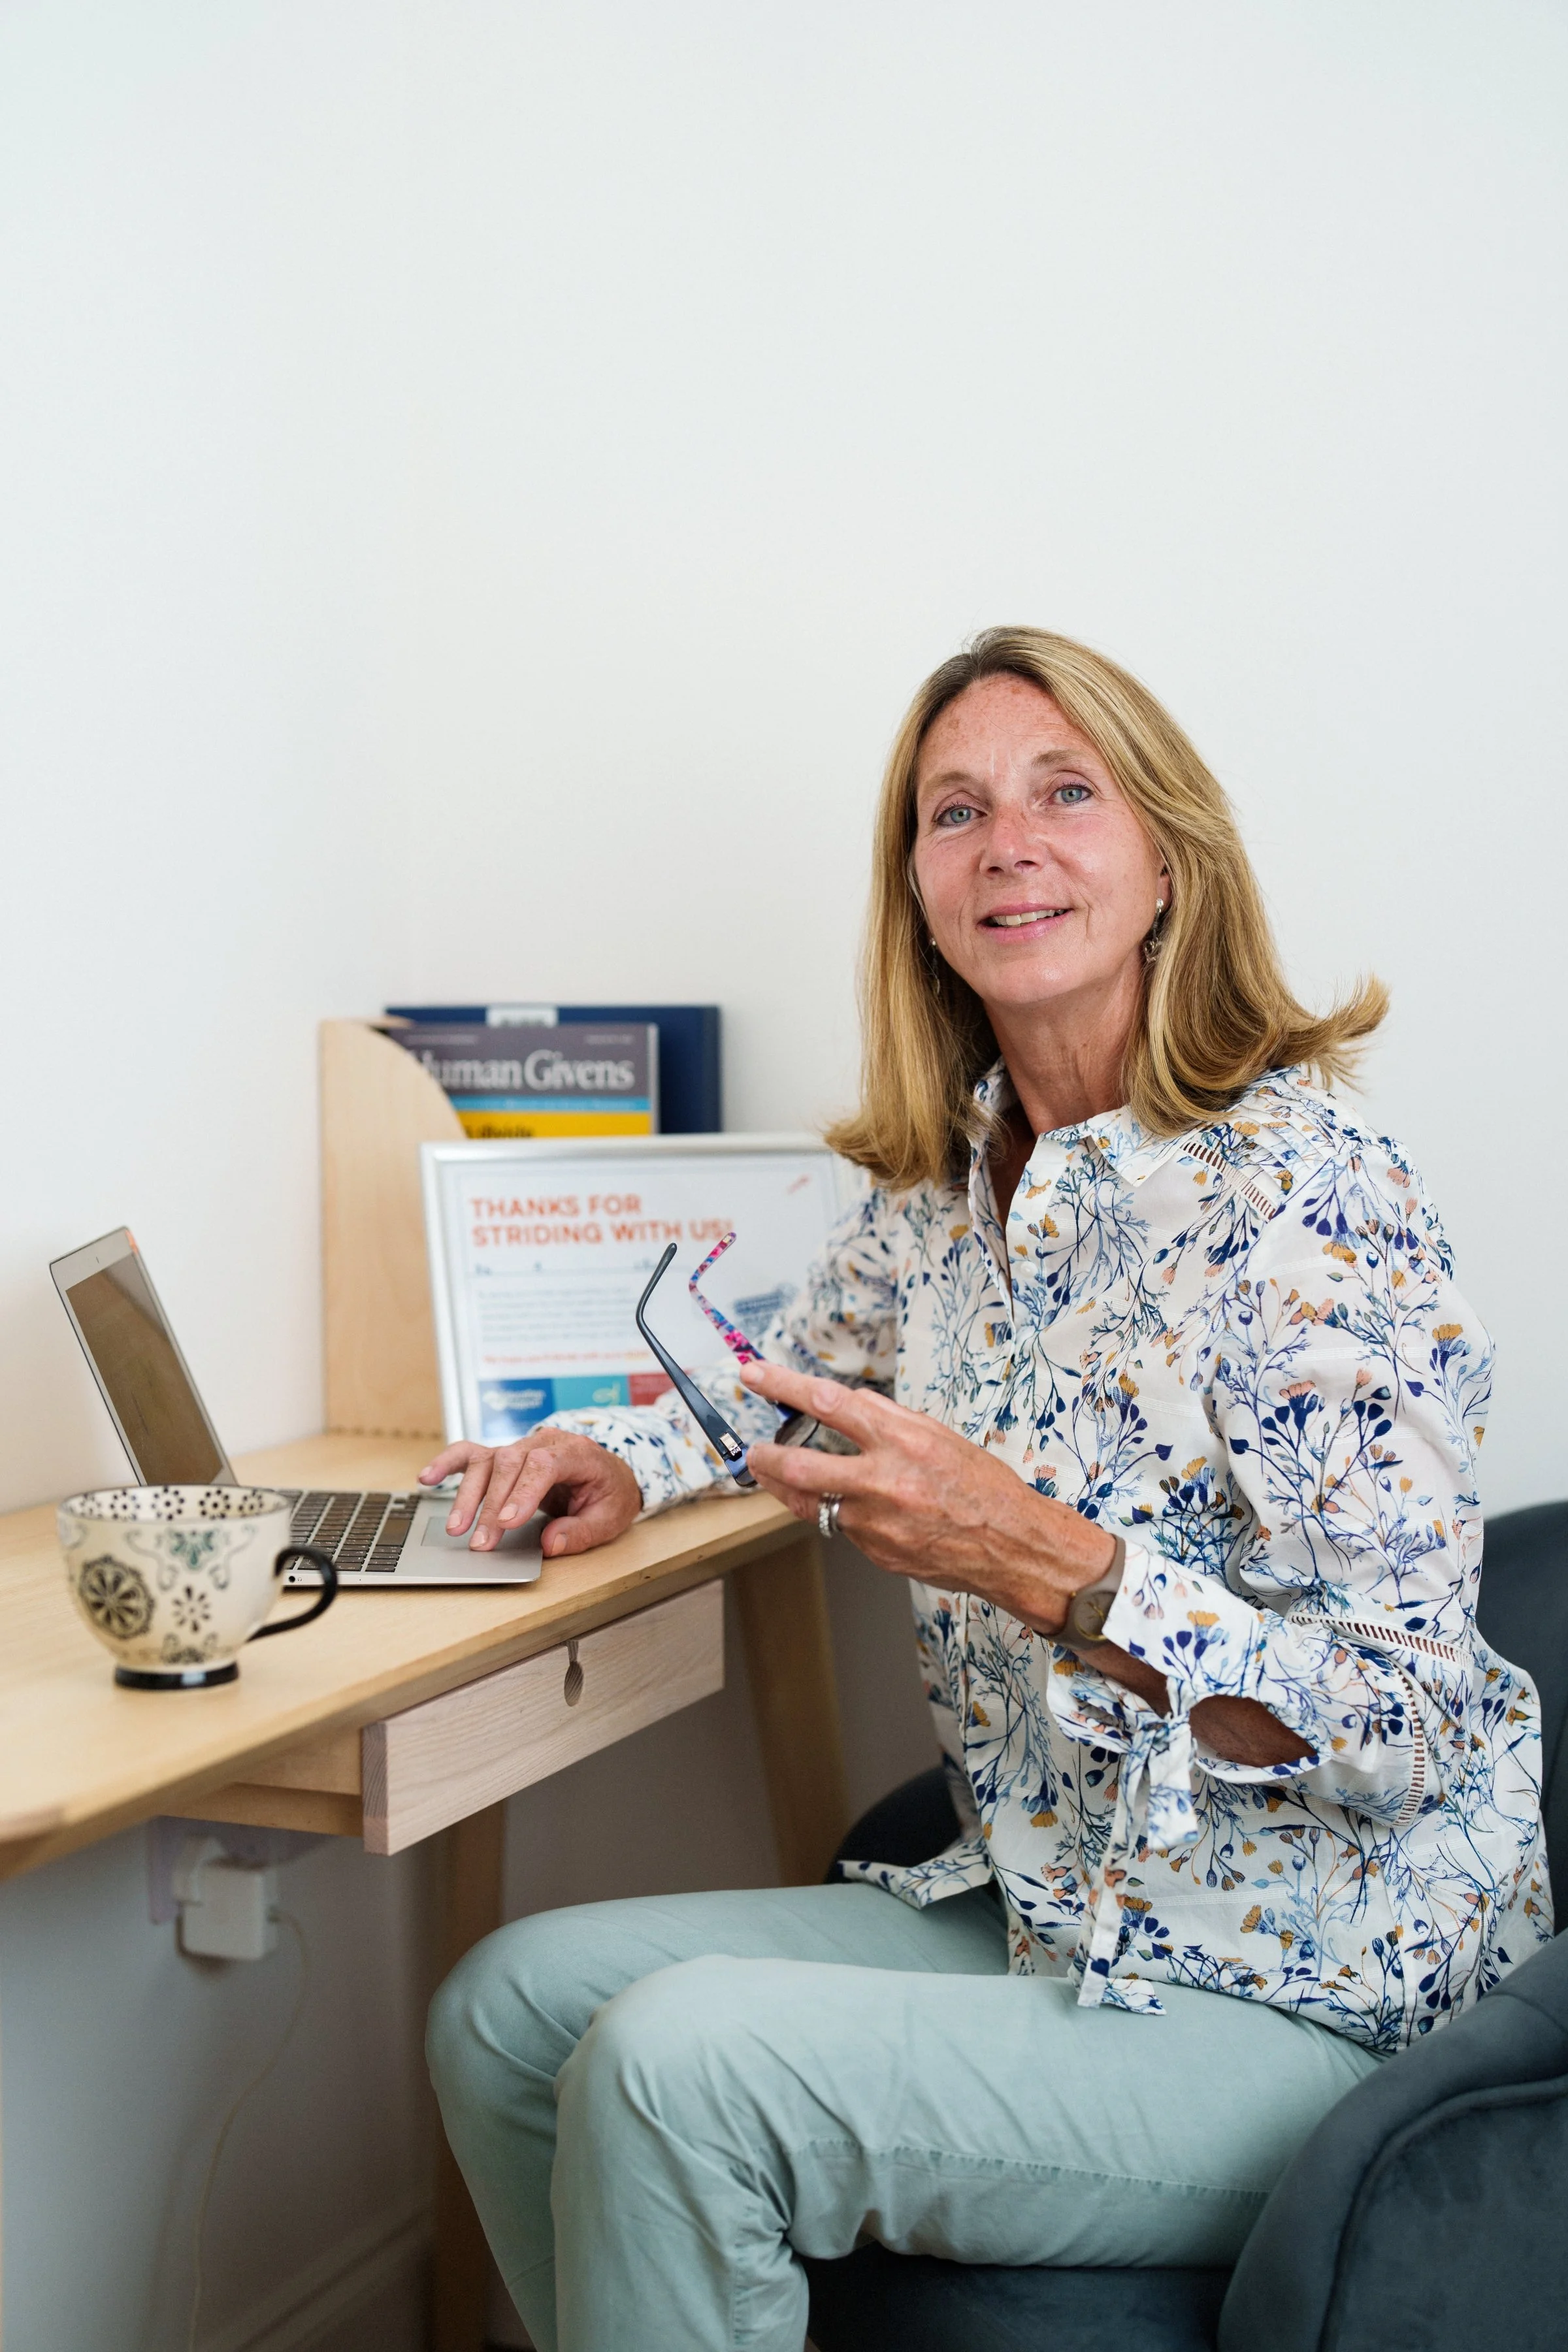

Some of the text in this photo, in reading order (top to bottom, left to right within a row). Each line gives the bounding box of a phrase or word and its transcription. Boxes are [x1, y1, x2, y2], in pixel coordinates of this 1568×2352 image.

[525, 1049, 635, 1090] Givens
[471, 1192, 642, 1218] THANKS FOR
[472, 1221, 603, 1247] STRIDING
[611, 1219, 682, 1243] WITH
